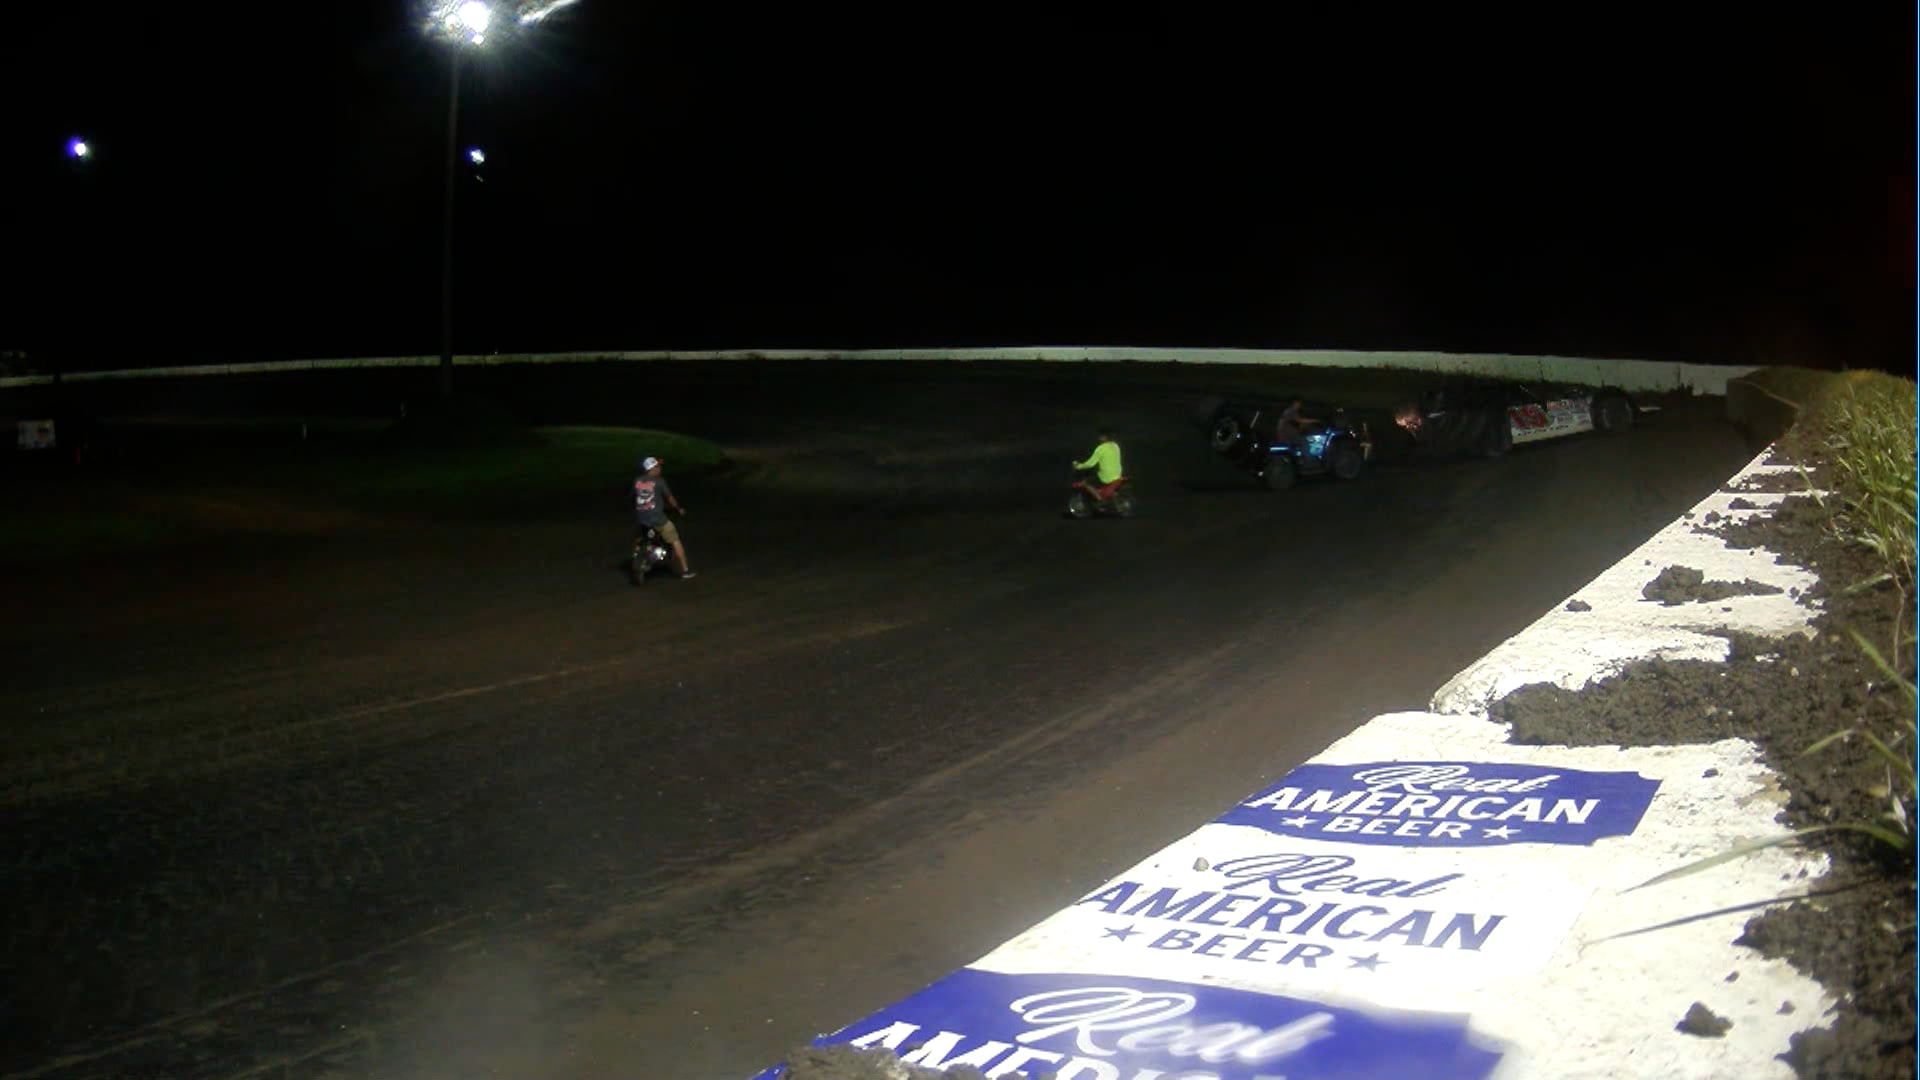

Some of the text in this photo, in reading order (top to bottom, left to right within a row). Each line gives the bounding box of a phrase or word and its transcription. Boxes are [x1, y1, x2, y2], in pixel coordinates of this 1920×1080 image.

[1353, 765, 1559, 795] Real
[1243, 787, 1600, 824] AMERICAN
[1321, 818, 1472, 839] BEER
[1212, 853, 1464, 898] Real
[1079, 881, 1506, 951] AMERICAN
[1146, 929, 1334, 968] BEER
[1009, 986, 1335, 1063] Real
